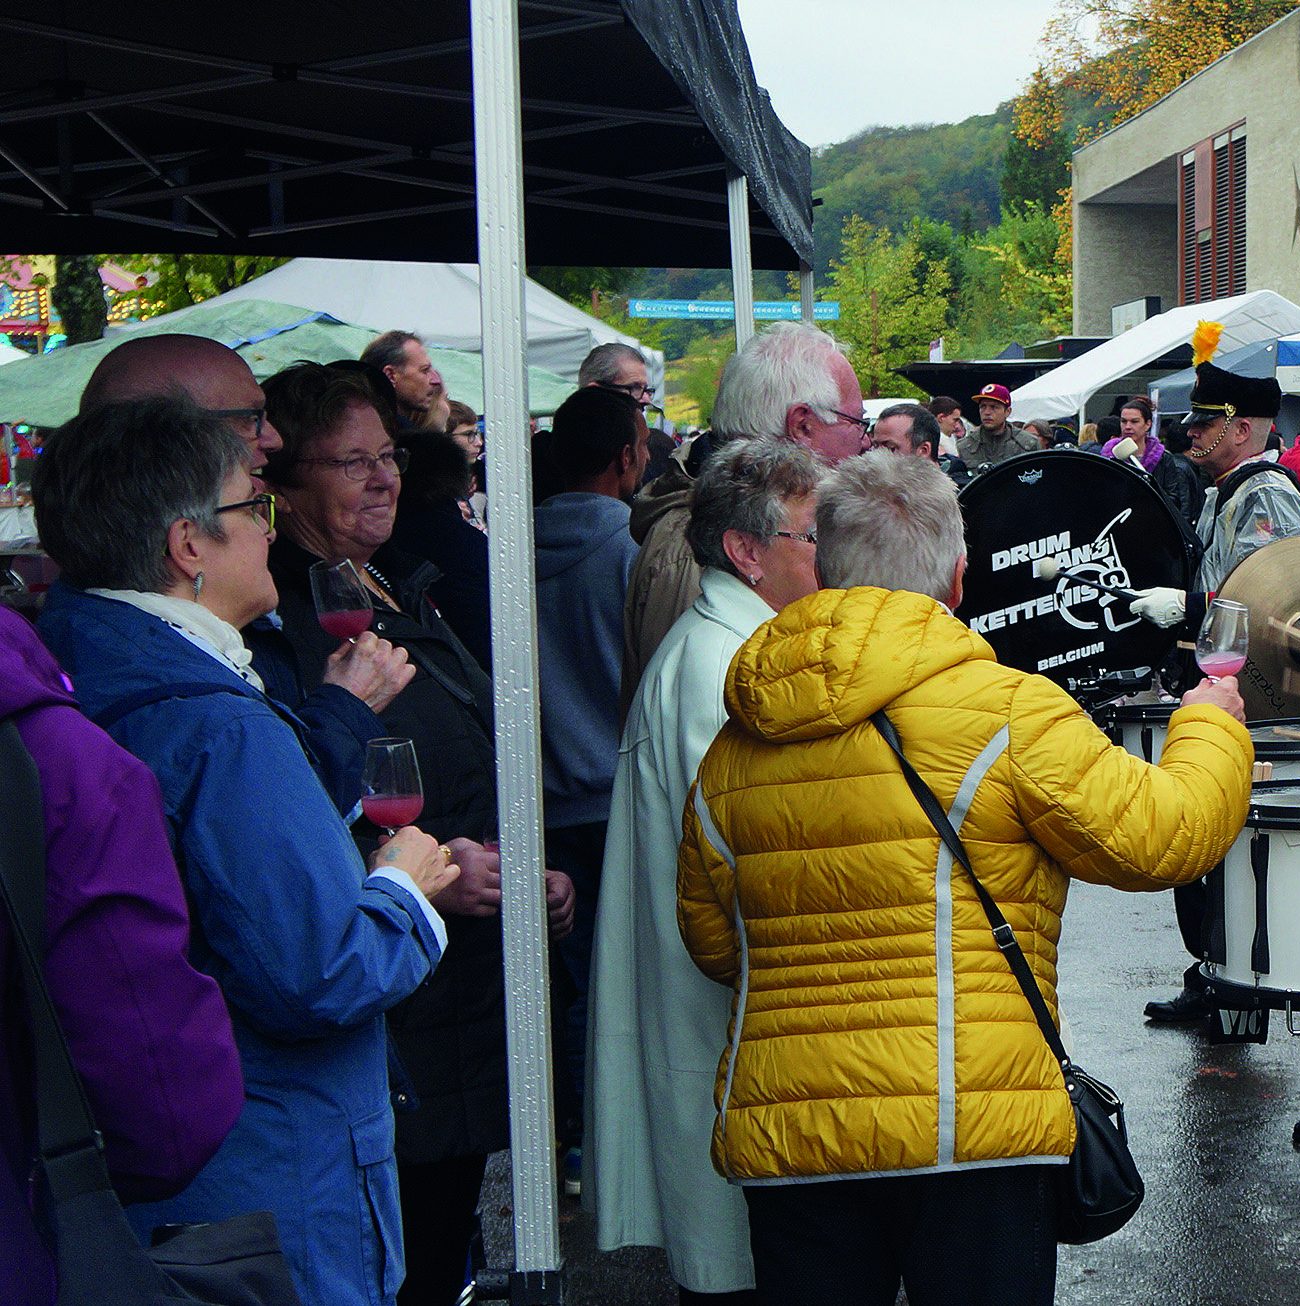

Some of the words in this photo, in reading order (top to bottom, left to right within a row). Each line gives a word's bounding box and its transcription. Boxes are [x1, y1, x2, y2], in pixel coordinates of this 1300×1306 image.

[992, 530, 1070, 571] DRUM
[970, 581, 1099, 634] KETTENIS
[1038, 642, 1104, 671] BELGIUM
[1246, 656, 1286, 711] tanbul
[1219, 1009, 1262, 1035] VIC
